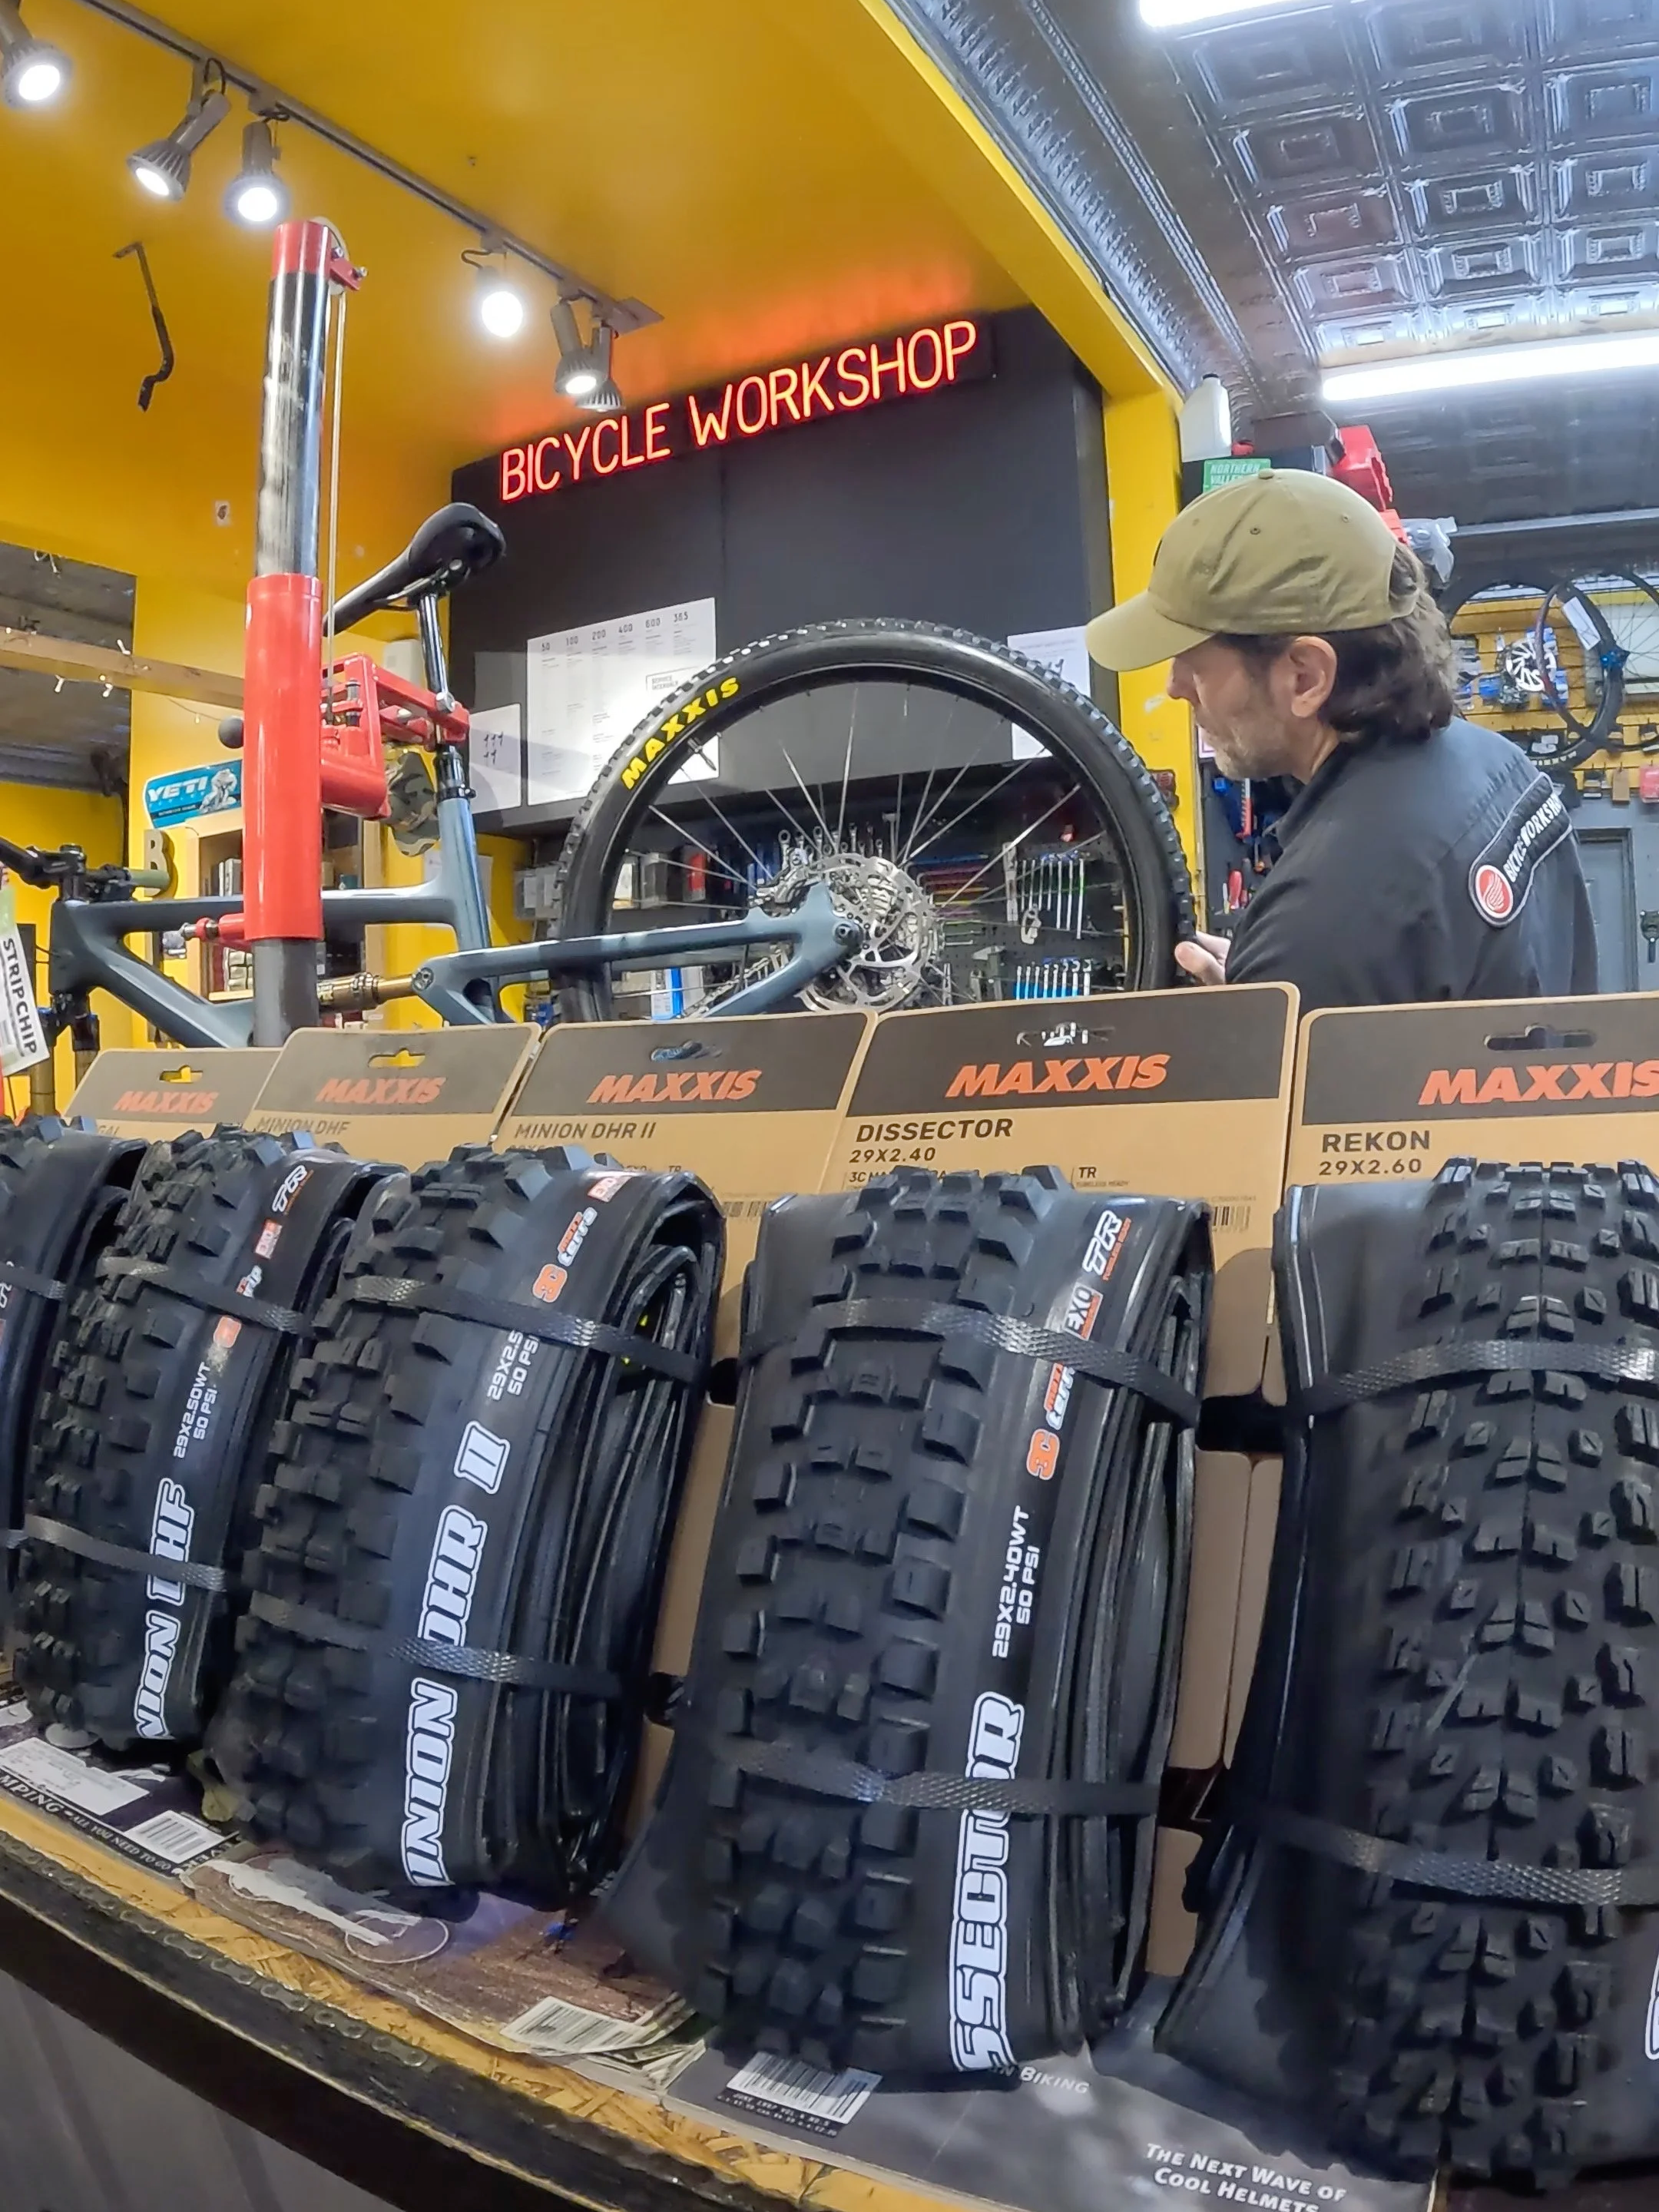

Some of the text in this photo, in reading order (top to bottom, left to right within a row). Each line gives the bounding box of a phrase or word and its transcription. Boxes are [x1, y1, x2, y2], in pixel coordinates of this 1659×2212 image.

[501, 320, 978, 503] BICYCLE WORKSHOP
[565, 635, 578, 646] 100
[591, 629, 606, 641] 200
[618, 623, 633, 634] 400
[621, 677, 739, 790] MAXXIS
[147, 776, 209, 803] YETI
[315, 1077, 447, 1104] MAXXIS
[586, 1068, 762, 1104] MAXXIS
[945, 1054, 1171, 1098] MAXXIS
[1418, 1059, 1659, 1106] MAXXIS
[113, 1091, 220, 1114] MAXXIS
[316, 1120, 350, 1135] DHF
[514, 1121, 657, 1140] MINION DHR II
[856, 1118, 1013, 1143] DISSECTOR
[1322, 1130, 1430, 1153] REKON
[849, 1147, 936, 1164] 29X2.40
[1319, 1158, 1422, 1176] 29X2.60
[1078, 1166, 1098, 1179] TR
[1081, 1210, 1122, 1276] TR
[1065, 1286, 1094, 1333] EXO
[507, 1367, 528, 1396] 50
[174, 1361, 210, 1459] 29X2.50WT
[193, 1388, 217, 1440] 50 PSI
[454, 1420, 511, 1495] II
[992, 1505, 1029, 1658] 29X2.40WT
[1015, 1545, 1040, 1625] 50 PSI
[113, 1836, 141, 1856] NEED
[138, 1850, 155, 1863] TO
[1020, 2066, 1091, 2094] BIKING
[1146, 2142, 1347, 2202] THE NEXT WAVE OF
[1154, 2167, 1320, 2212] COOL HELMETS
